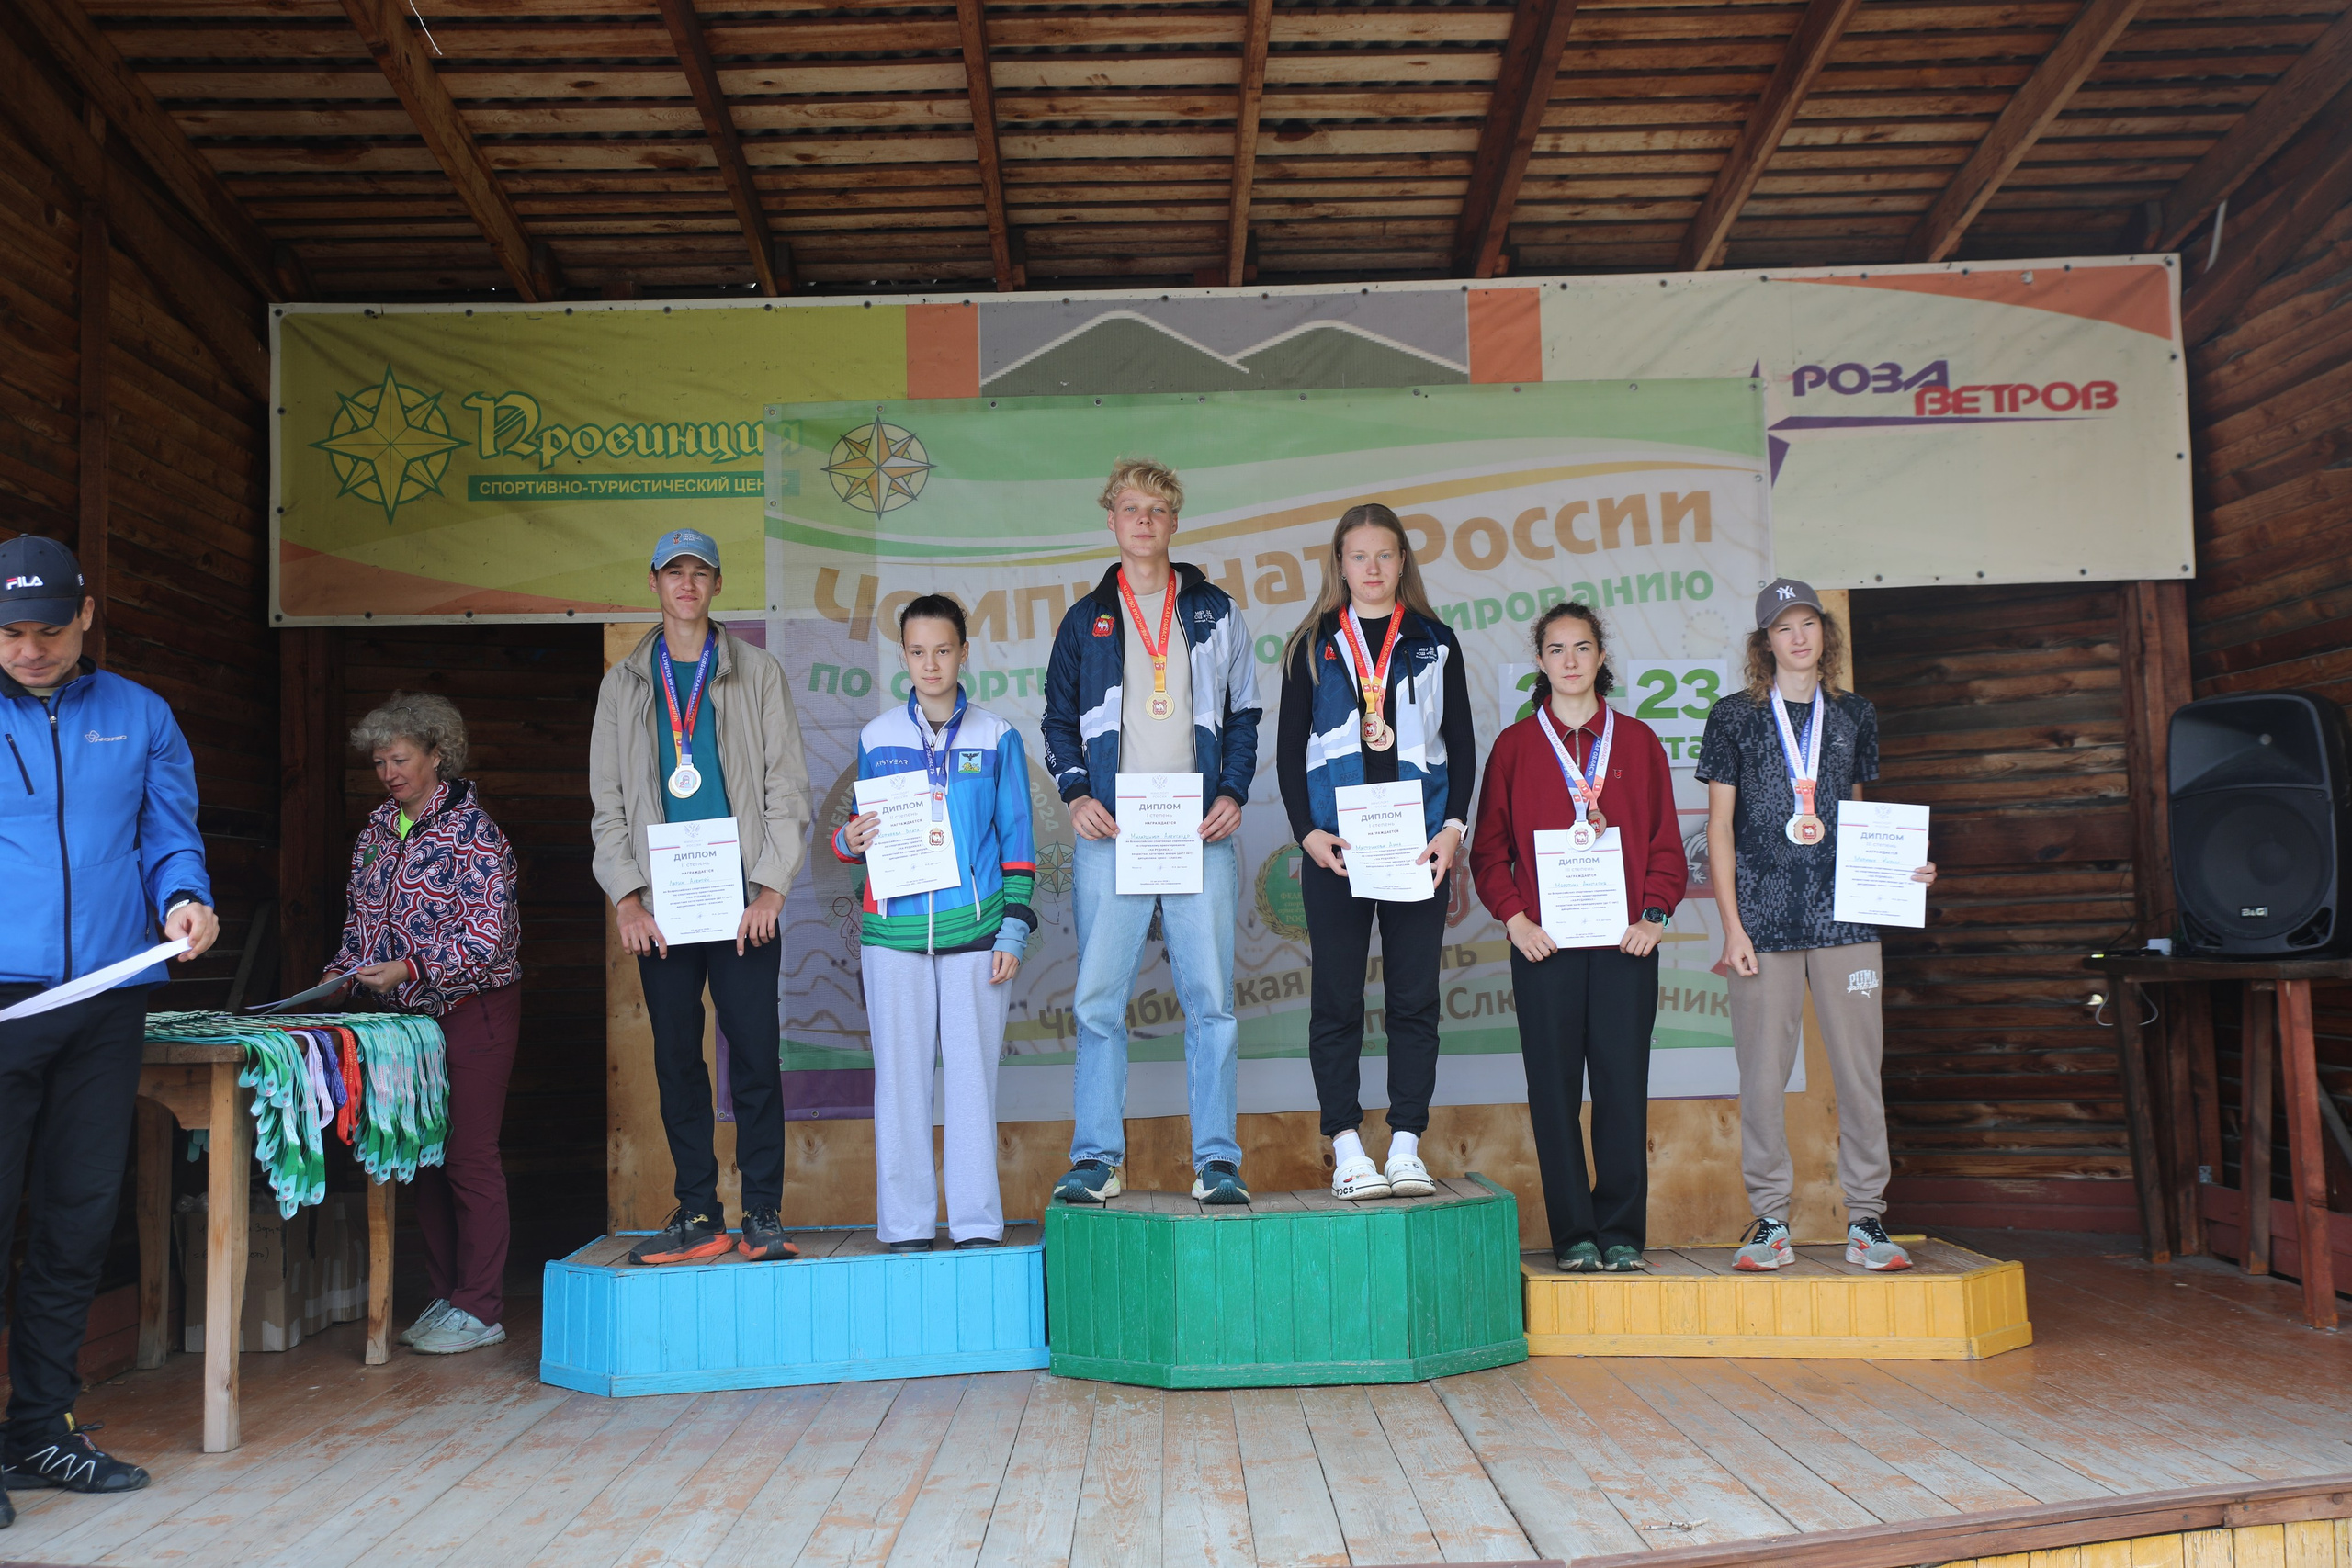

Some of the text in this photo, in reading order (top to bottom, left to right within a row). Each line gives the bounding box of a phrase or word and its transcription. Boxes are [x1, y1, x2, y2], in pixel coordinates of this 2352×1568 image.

[1793, 359, 1949, 397] РОЗА
[1914, 380, 2119, 416] ВЕТРОВ
[480, 476, 729, 496] СПОРТИВНО-ТУРИСТИЧЕСКИЙ
[6, 575, 44, 591] FILA
[808, 662, 872, 698] по
[882, 800, 924, 815] ДИПЛОМ
[1139, 803, 1181, 811] ДИПЛОМ
[1361, 811, 1402, 822] ДИПЛОМ
[1860, 831, 1904, 840] ДИПЛОМ
[673, 850, 717, 862] ДИПЛОМ
[1558, 856, 1600, 866] ДИПЛОМ
